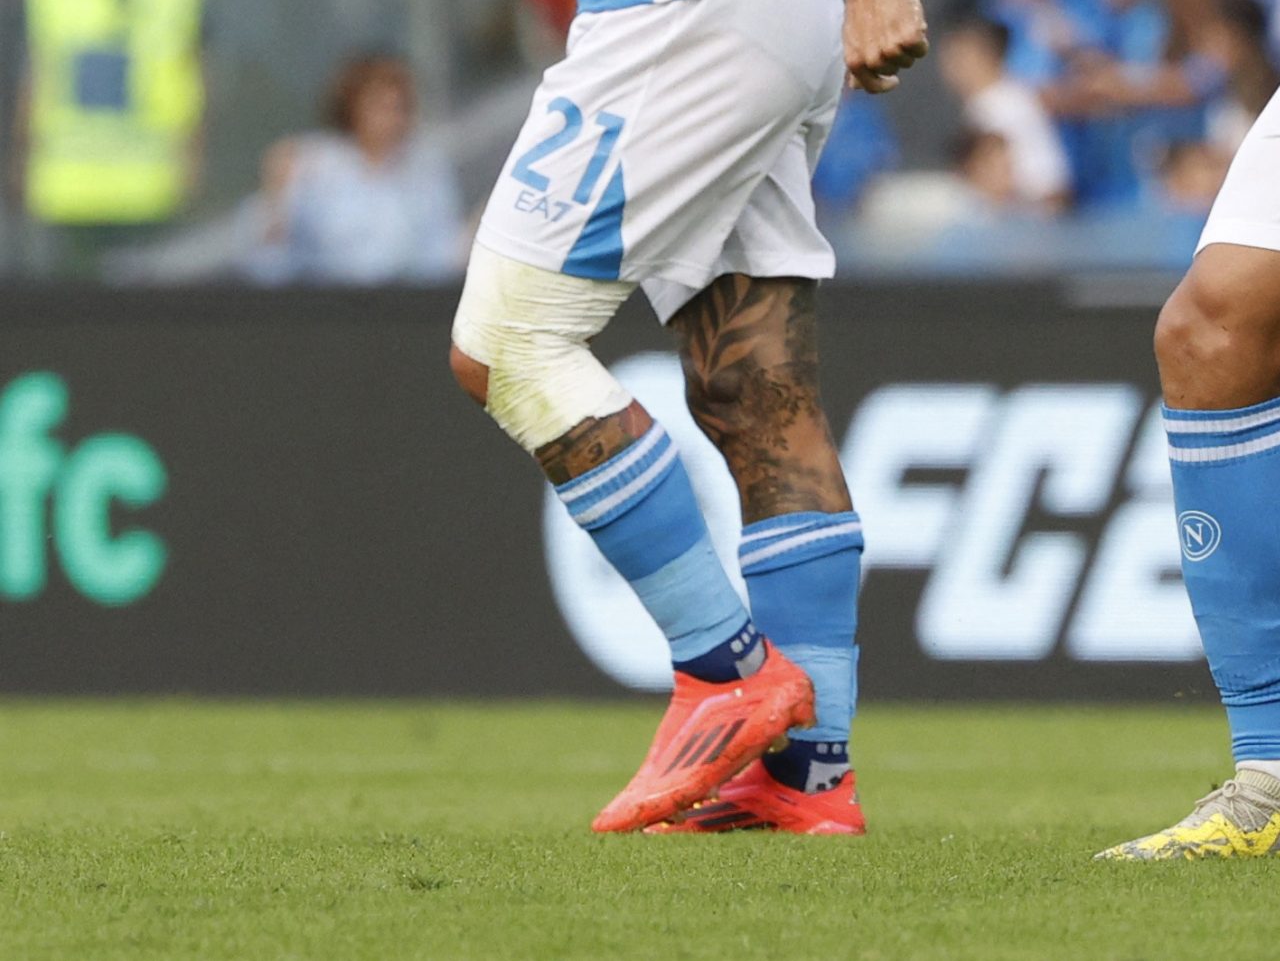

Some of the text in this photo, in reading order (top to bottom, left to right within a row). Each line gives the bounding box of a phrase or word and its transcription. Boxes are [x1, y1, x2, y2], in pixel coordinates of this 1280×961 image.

[510, 95, 626, 206] 21
[513, 189, 574, 223] EA7
[0, 370, 168, 607] fc
